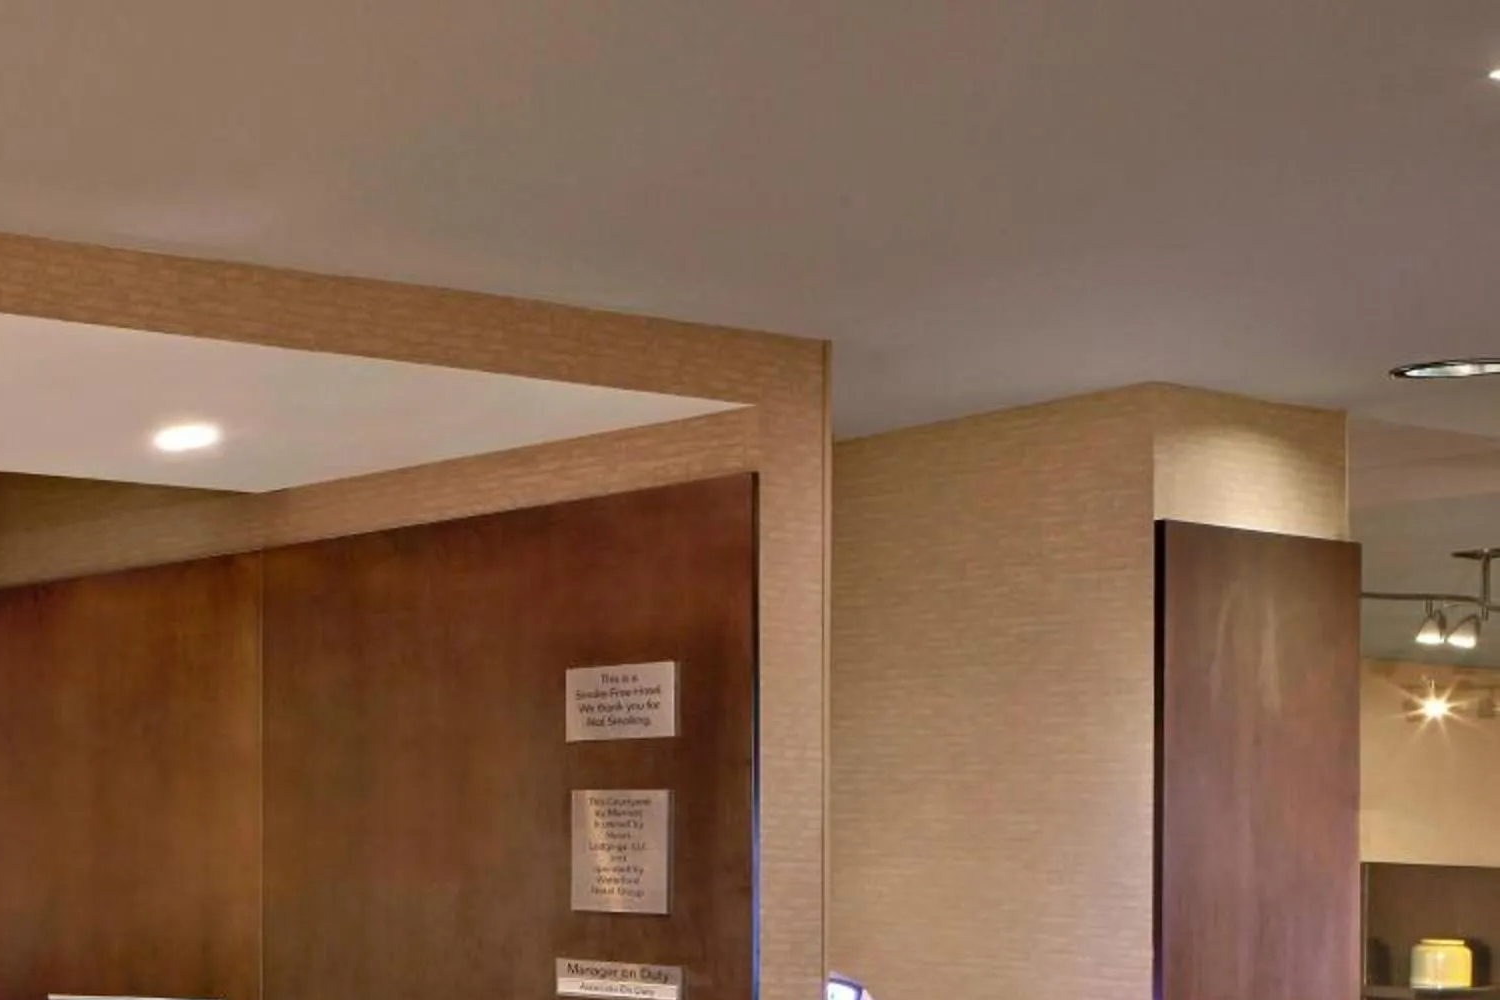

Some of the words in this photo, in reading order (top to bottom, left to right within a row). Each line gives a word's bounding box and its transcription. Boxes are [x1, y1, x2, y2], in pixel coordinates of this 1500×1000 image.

[566, 962, 618, 979] Manager
[620, 968, 637, 979] on
[640, 967, 670, 985] Duty
